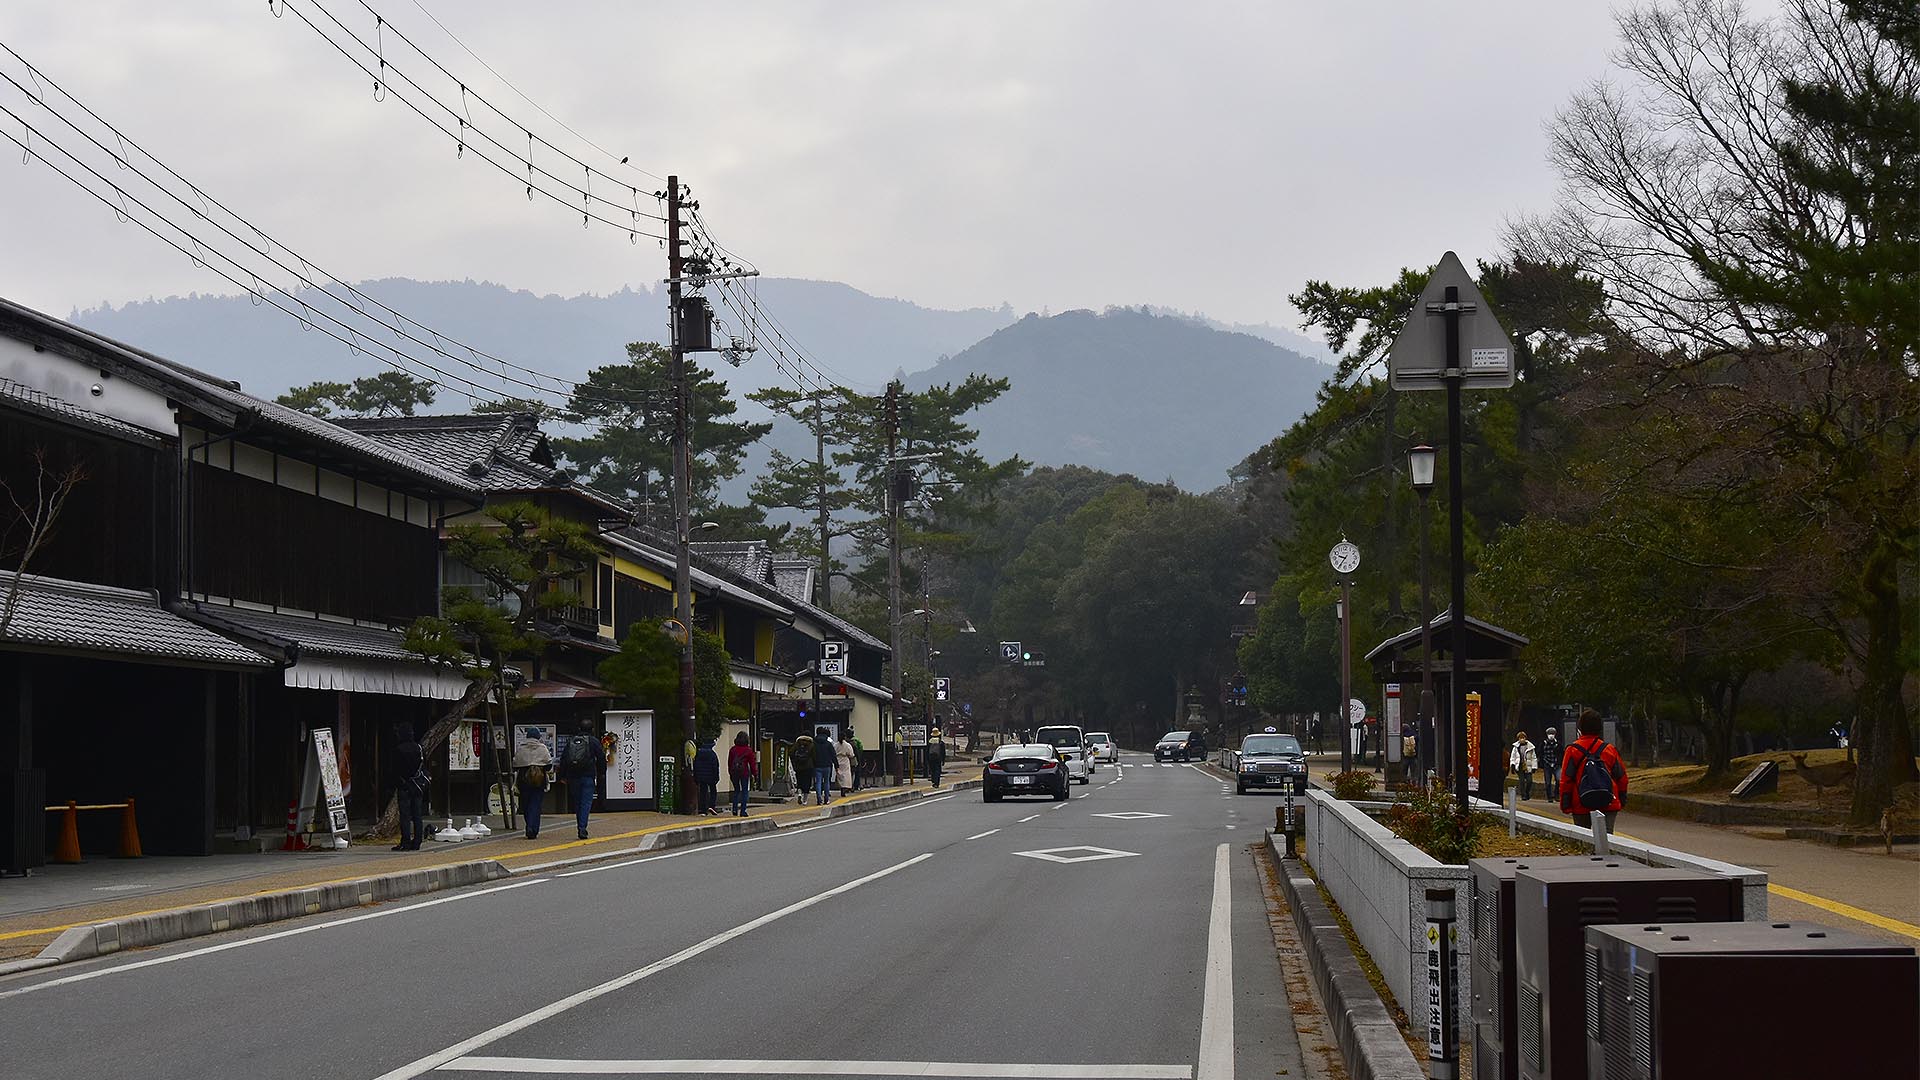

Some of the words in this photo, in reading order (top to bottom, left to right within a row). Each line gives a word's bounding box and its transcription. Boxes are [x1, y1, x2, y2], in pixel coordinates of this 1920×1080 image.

[825, 644, 838, 658] P
[936, 680, 945, 689] P
[623, 715, 635, 780] 夢風ひろば
[1428, 949, 1441, 1045] 鹿飛出注意
